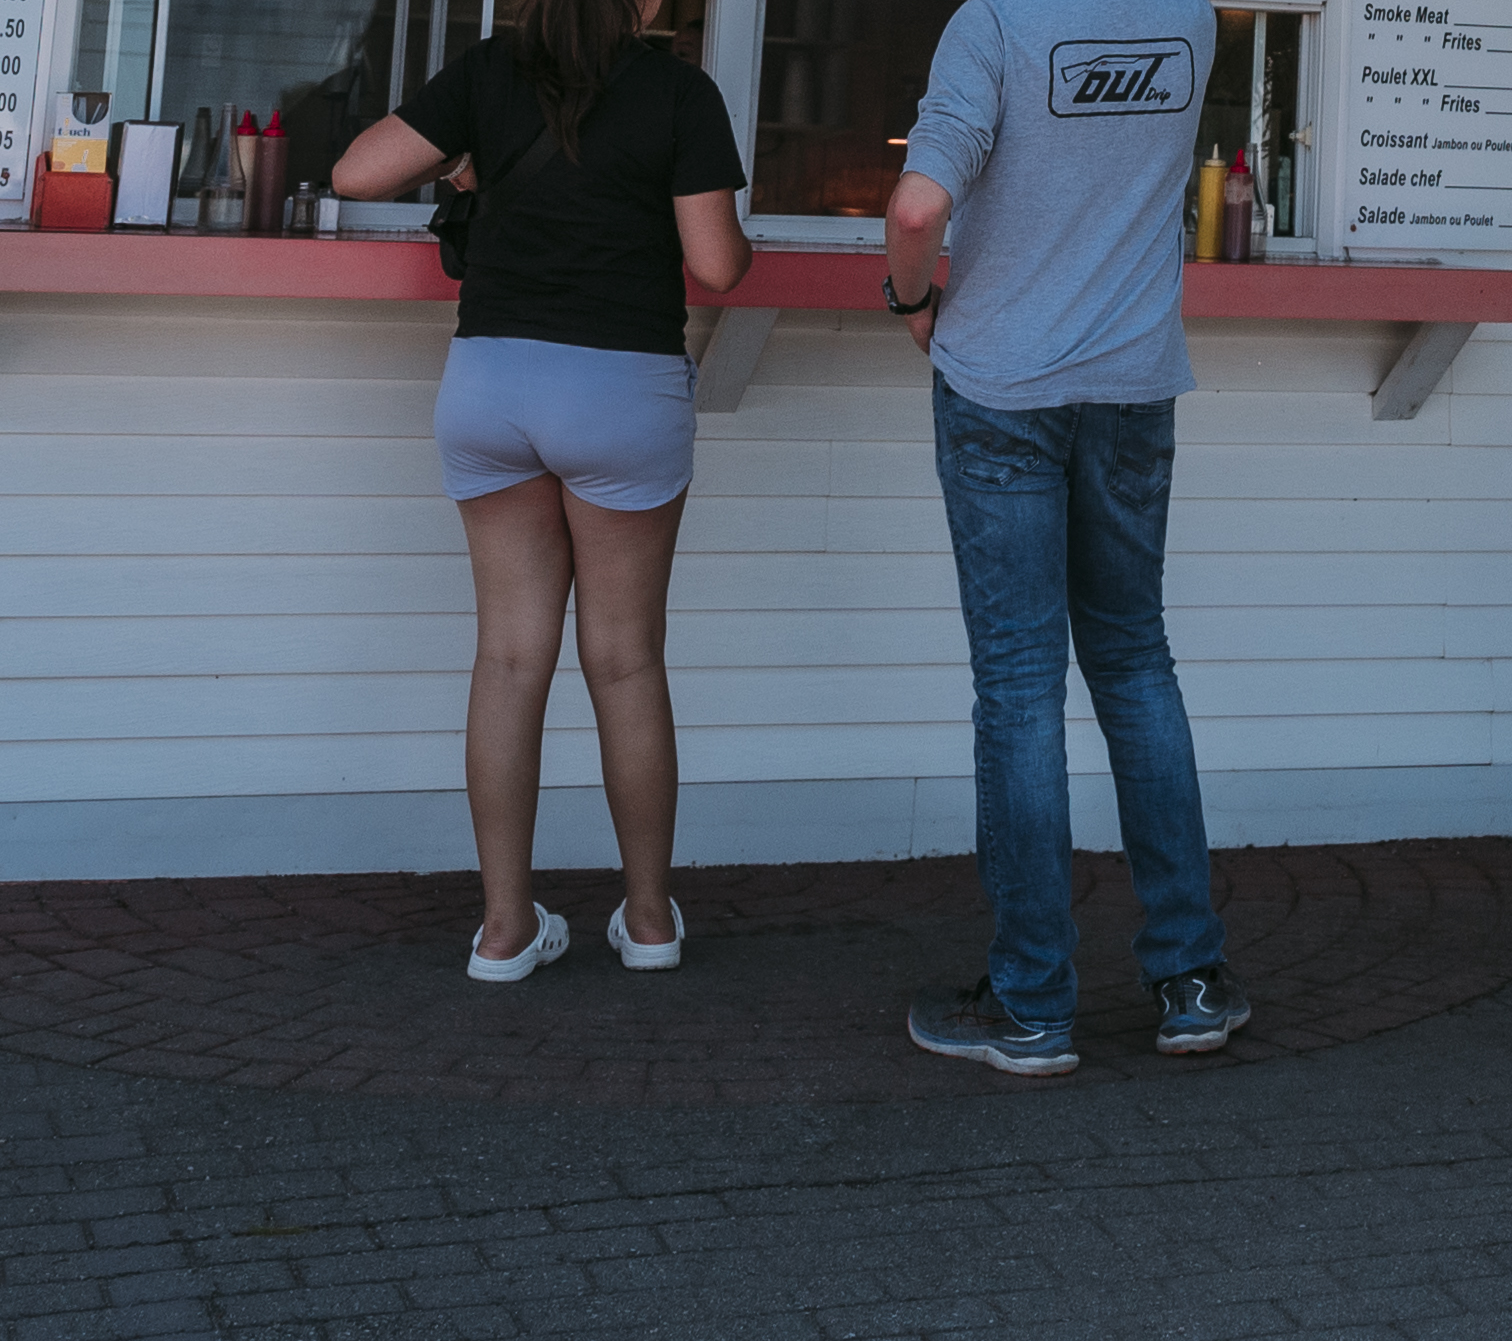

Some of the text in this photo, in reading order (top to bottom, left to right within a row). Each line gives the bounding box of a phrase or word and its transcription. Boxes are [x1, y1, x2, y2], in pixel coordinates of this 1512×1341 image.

[1364, 3, 1411, 22] Smoke
[1416, 6, 1449, 24] Meat
[1362, 66, 1407, 85] Poulet
[1410, 68, 1438, 86] XXL
[1145, 87, 1172, 105] Drip
[1361, 129, 1428, 149] Croissant
[1432, 138, 1468, 150] Jambon
[1471, 142, 1482, 150] ou
[1359, 168, 1406, 186] Salade
[1411, 170, 1442, 187] chef
